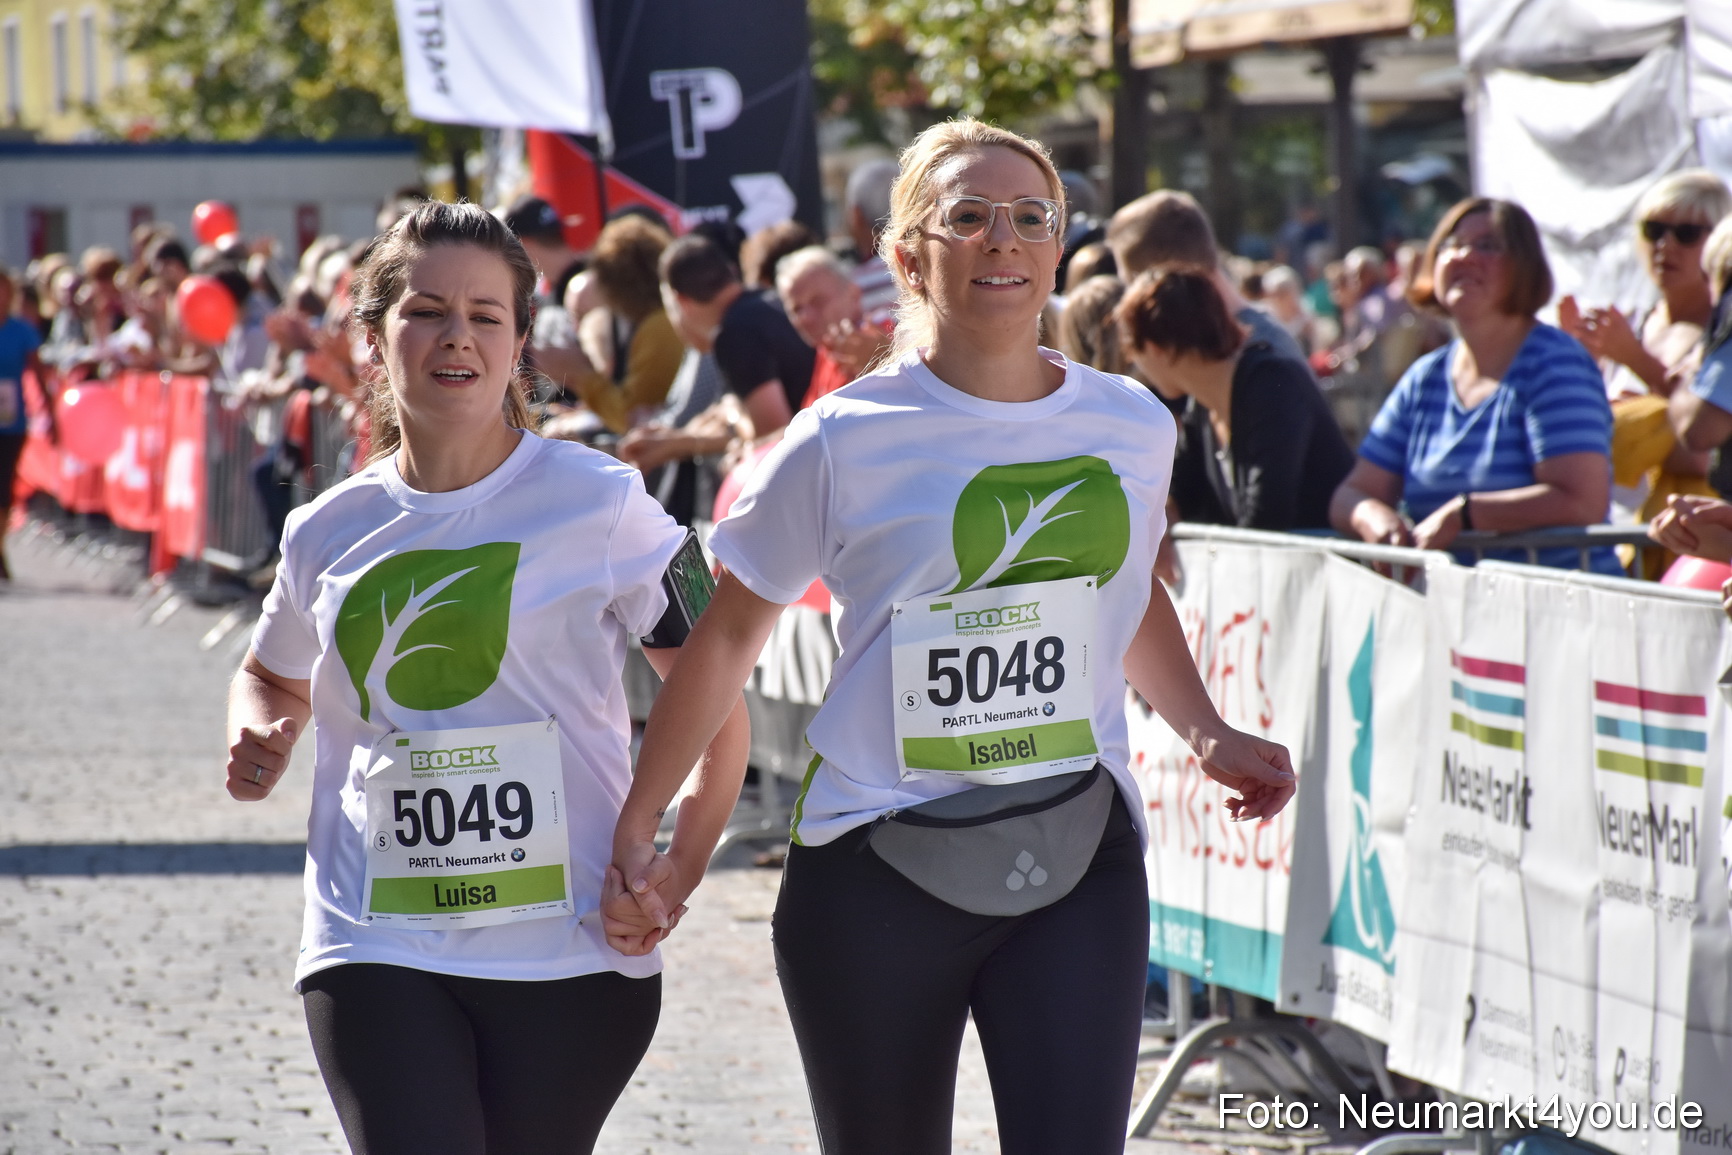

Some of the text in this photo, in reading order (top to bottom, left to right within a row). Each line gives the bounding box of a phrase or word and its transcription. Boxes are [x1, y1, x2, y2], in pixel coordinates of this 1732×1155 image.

[955, 601, 1041, 629] BOCK
[956, 623, 1042, 637] inspired by smart concepts
[927, 636, 1065, 706] 5048
[907, 695, 915, 707] S
[942, 706, 1039, 728] PARTL Neumarkt
[410, 745, 499, 771] BOCK
[968, 733, 1038, 765] Isabel
[411, 766, 501, 779] inspired by smart concepts
[393, 781, 533, 848] 5049
[378, 836, 386, 847] S
[409, 852, 506, 868] PARTL Neumarkt
[433, 882, 497, 908] Luisa
